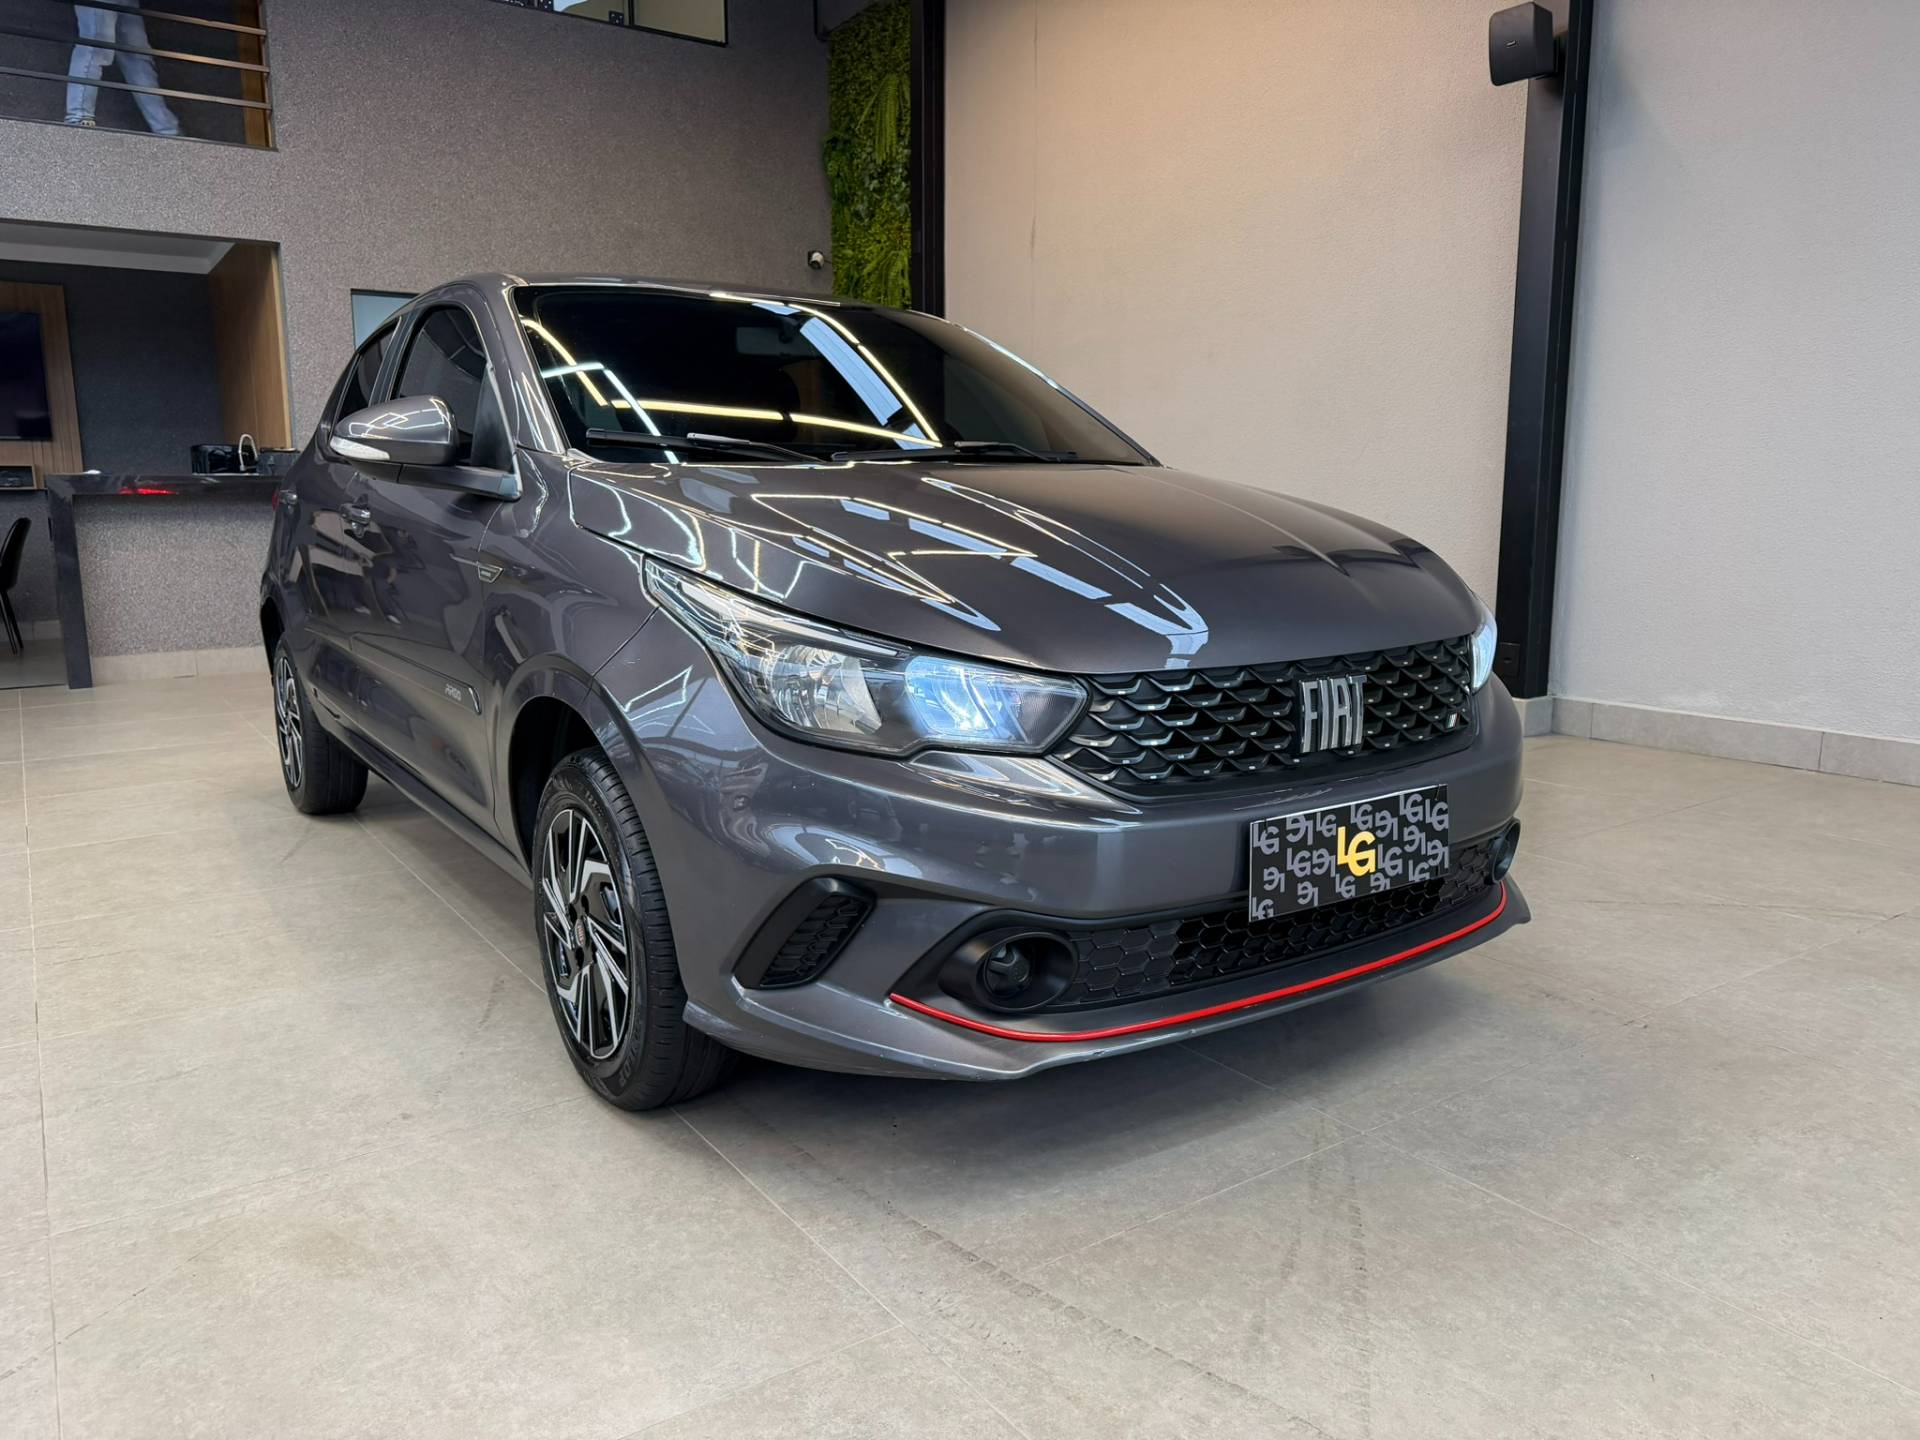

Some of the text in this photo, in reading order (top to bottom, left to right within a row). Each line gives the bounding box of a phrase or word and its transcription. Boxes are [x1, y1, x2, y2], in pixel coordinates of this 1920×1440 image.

[1300, 675, 1367, 753] FIAT
[1351, 804, 1372, 830] LG
[1400, 794, 1423, 823] LG
[1426, 799, 1449, 831] LG
[1253, 823, 1279, 855] LG
[1316, 812, 1336, 837] LG
[1287, 848, 1311, 878] LG
[1338, 826, 1376, 877] LG
[1378, 844, 1403, 876] LG
[1335, 874, 1355, 899] LG
